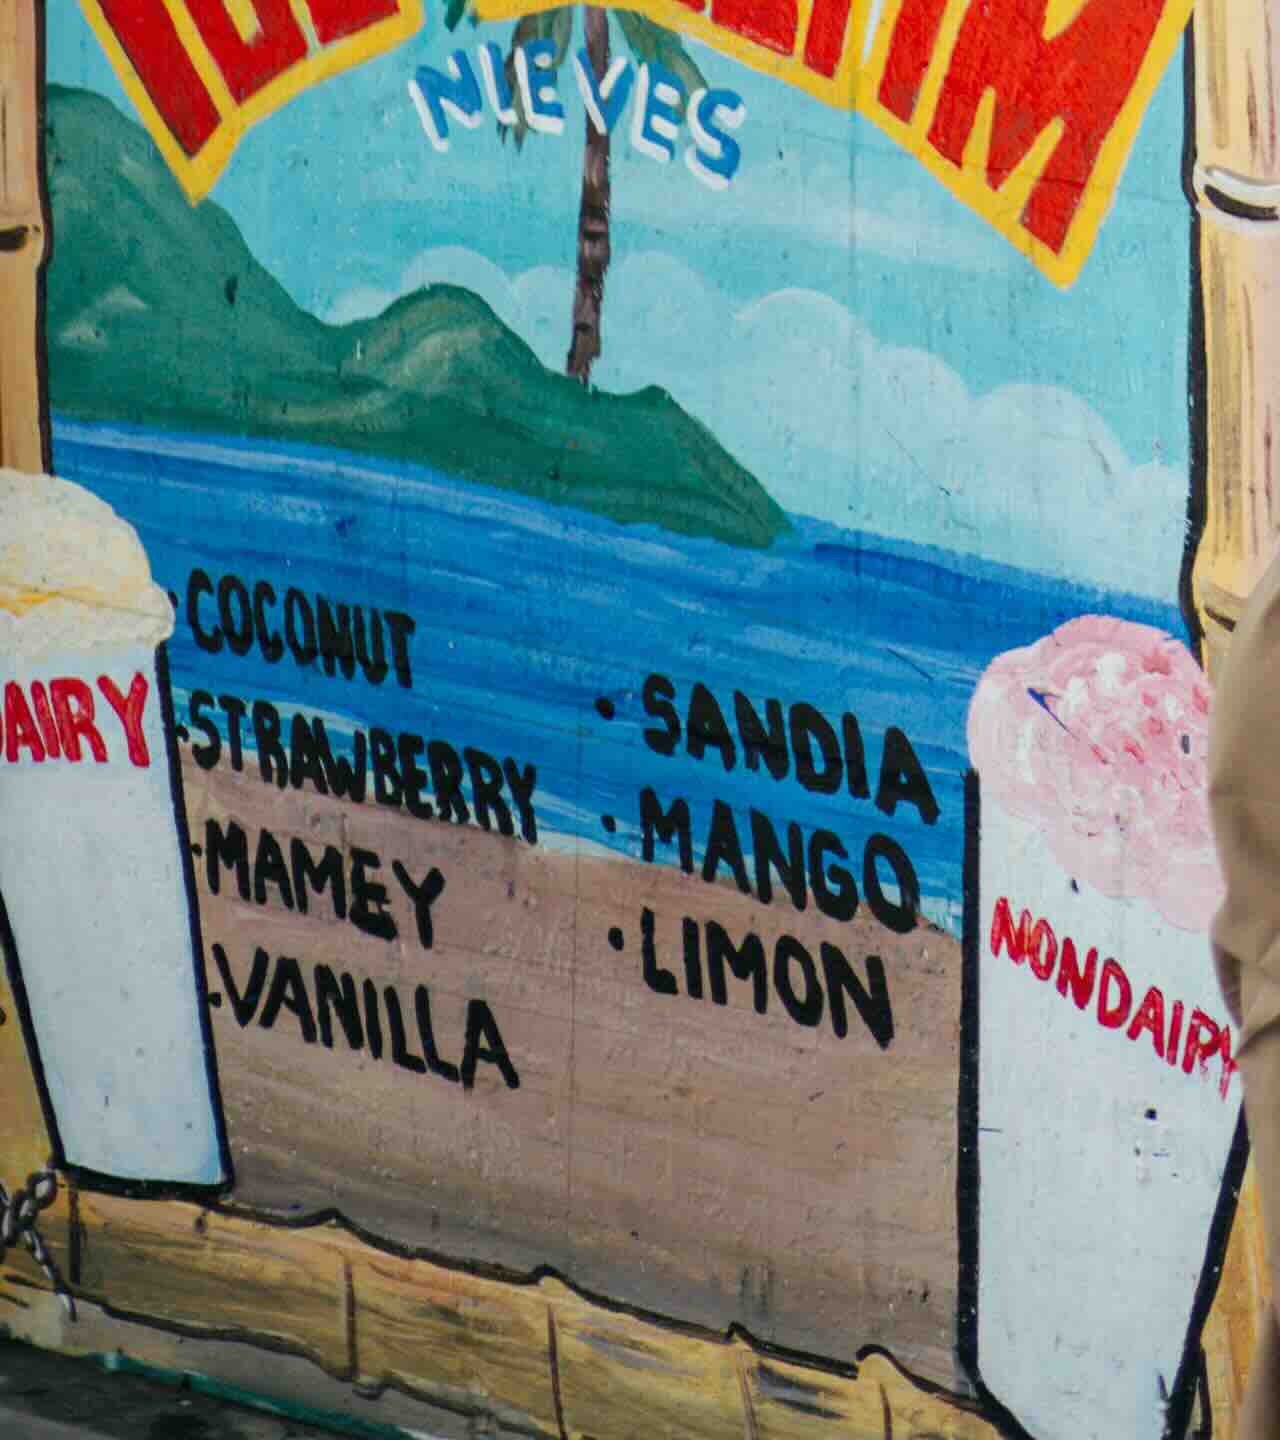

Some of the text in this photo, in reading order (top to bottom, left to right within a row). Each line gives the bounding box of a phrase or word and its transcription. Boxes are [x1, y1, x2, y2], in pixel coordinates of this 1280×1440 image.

[407, 36, 748, 192] NIEVES
[186, 568, 418, 689] COCONUT
[0, 673, 153, 768] AIRY
[186, 690, 539, 844] STRAWBERRY
[642, 675, 940, 826] SANDIA
[206, 817, 446, 950] MAMEY
[639, 786, 922, 936] MANGO
[214, 942, 521, 1091] VANILLA
[641, 910, 895, 1049] LIMON
